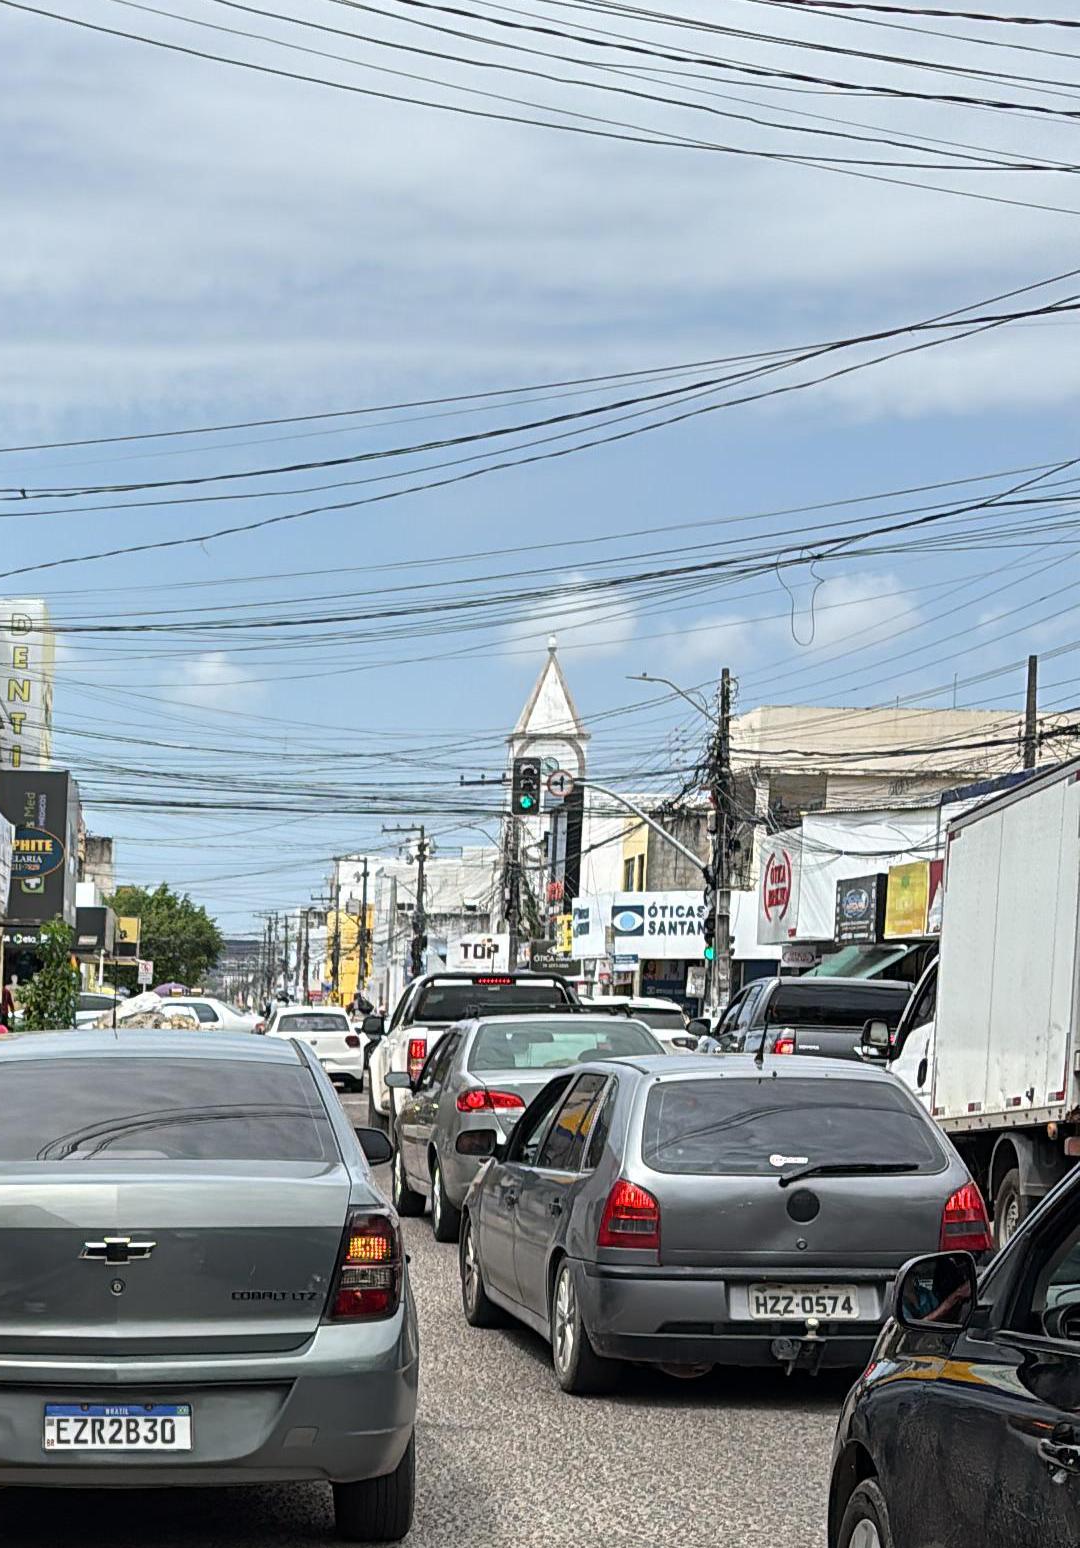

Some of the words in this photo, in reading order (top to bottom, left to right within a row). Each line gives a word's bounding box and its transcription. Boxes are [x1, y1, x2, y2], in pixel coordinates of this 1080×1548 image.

[12, 839, 53, 852] PHITE
[647, 902, 706, 918] ÓTICAS
[647, 920, 706, 936] SANTAN
[460, 943, 499, 959] TOP
[231, 1291, 287, 1301] COBALT
[291, 1291, 318, 1301] LTZ
[56, 1417, 176, 1445] EZR2B30
